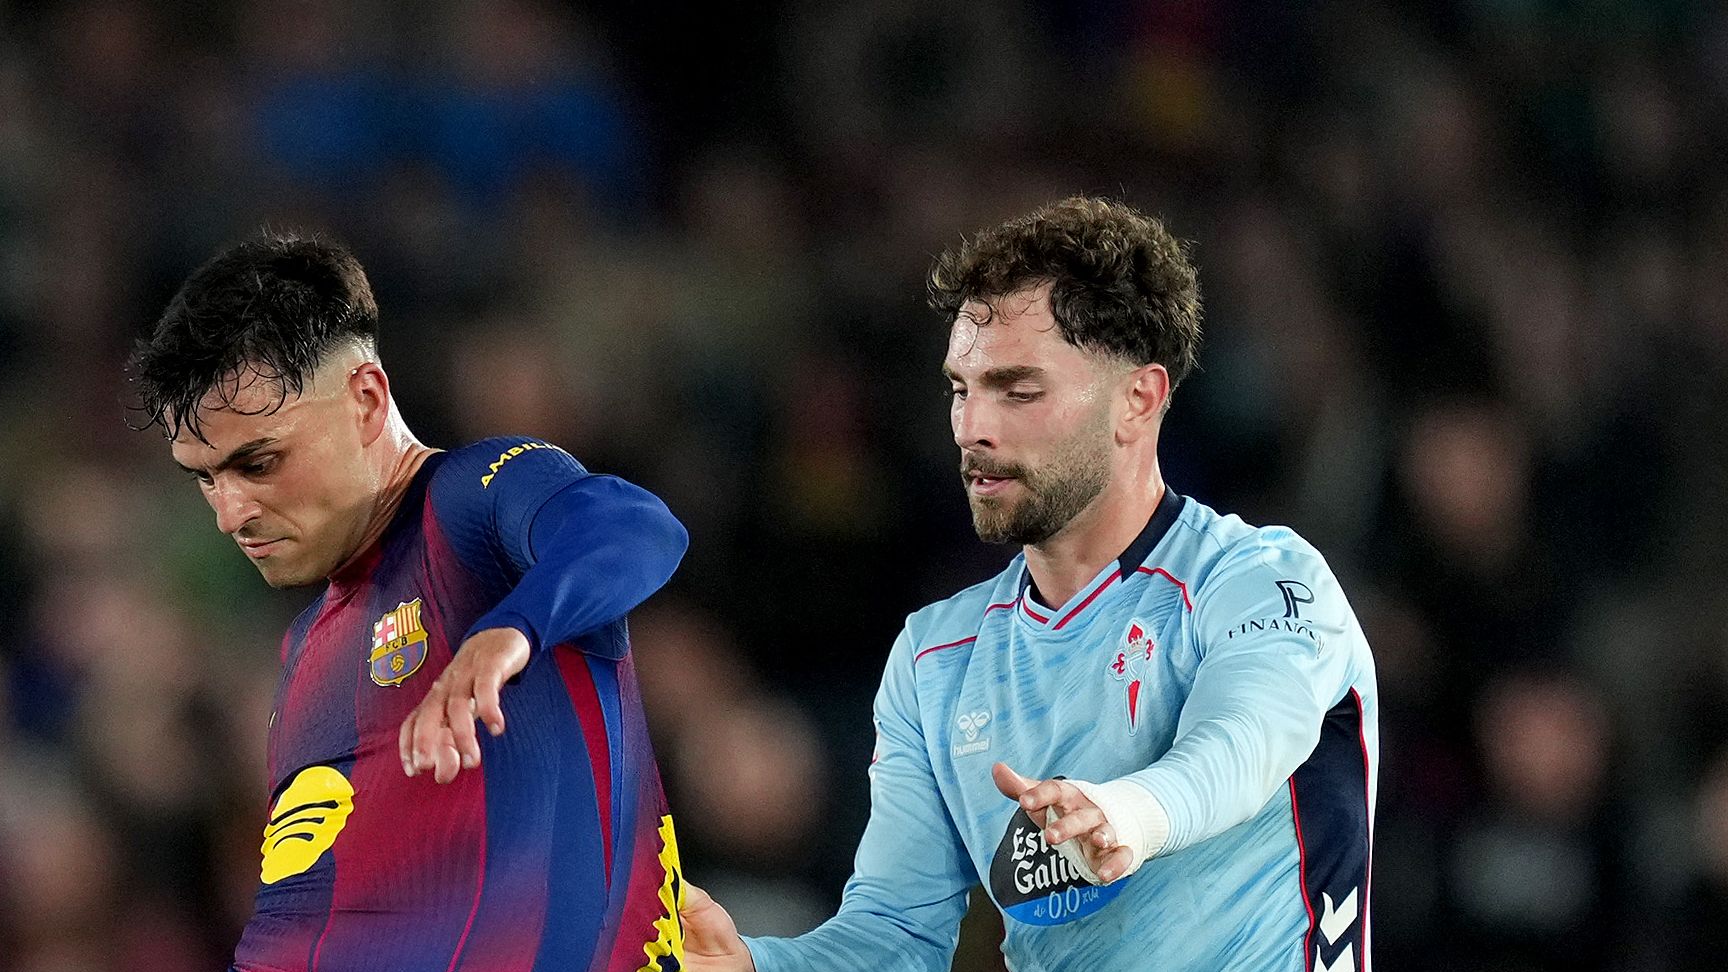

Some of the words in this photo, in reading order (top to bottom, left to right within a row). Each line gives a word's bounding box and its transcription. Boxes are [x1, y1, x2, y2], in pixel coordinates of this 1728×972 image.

[953, 737, 990, 757] hummel
[1014, 853, 1081, 895] Galic
[1048, 884, 1080, 919] 0,0
